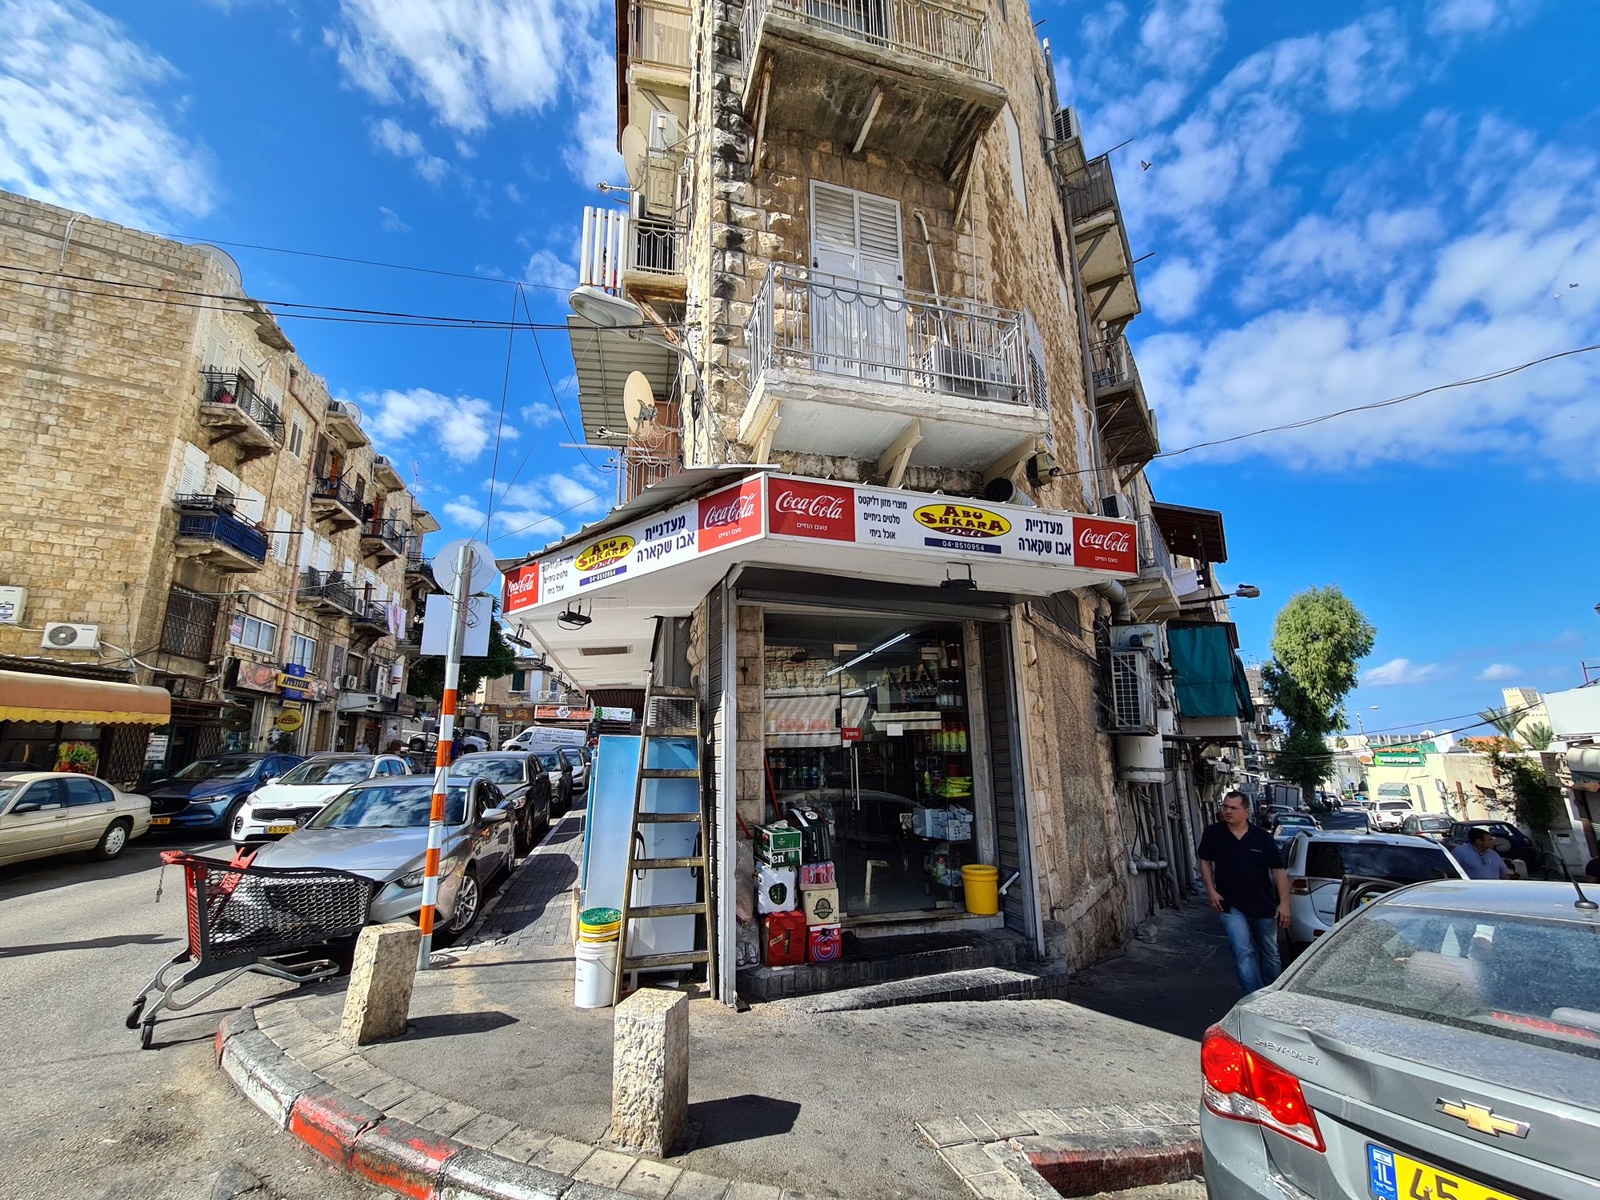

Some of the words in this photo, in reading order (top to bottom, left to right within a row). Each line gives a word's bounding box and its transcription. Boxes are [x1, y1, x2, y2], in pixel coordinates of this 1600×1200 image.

[704, 493, 756, 530] Coca-Cola
[775, 491, 846, 519] Coca-Cola
[880, 499, 891, 509] מזון
[892, 500, 908, 510] מוצרי
[864, 512, 881, 521] ביתיים
[883, 513, 901, 524] סלטים
[942, 505, 984, 520] ABU
[645, 515, 686, 542] מעדניית
[797, 522, 813, 530] החיים
[814, 523, 827, 531] טעם
[920, 511, 1005, 532] SHKARA
[1025, 518, 1063, 535] מעדניית
[870, 529, 882, 538] ביתי
[883, 528, 896, 539] אוכל
[946, 527, 982, 537] Deli
[1079, 527, 1131, 553] Coca-Cola
[676, 532, 695, 550] אבו
[942, 540, 985, 551] 04-8510954
[1018, 537, 1052, 556] שקארה
[1055, 542, 1071, 556] אבו
[579, 541, 630, 568] SHKARA
[637, 539, 673, 563] שקארה
[1253, 1035, 1320, 1066] CHEVROLET
[1377, 1163, 1392, 1185] IL
